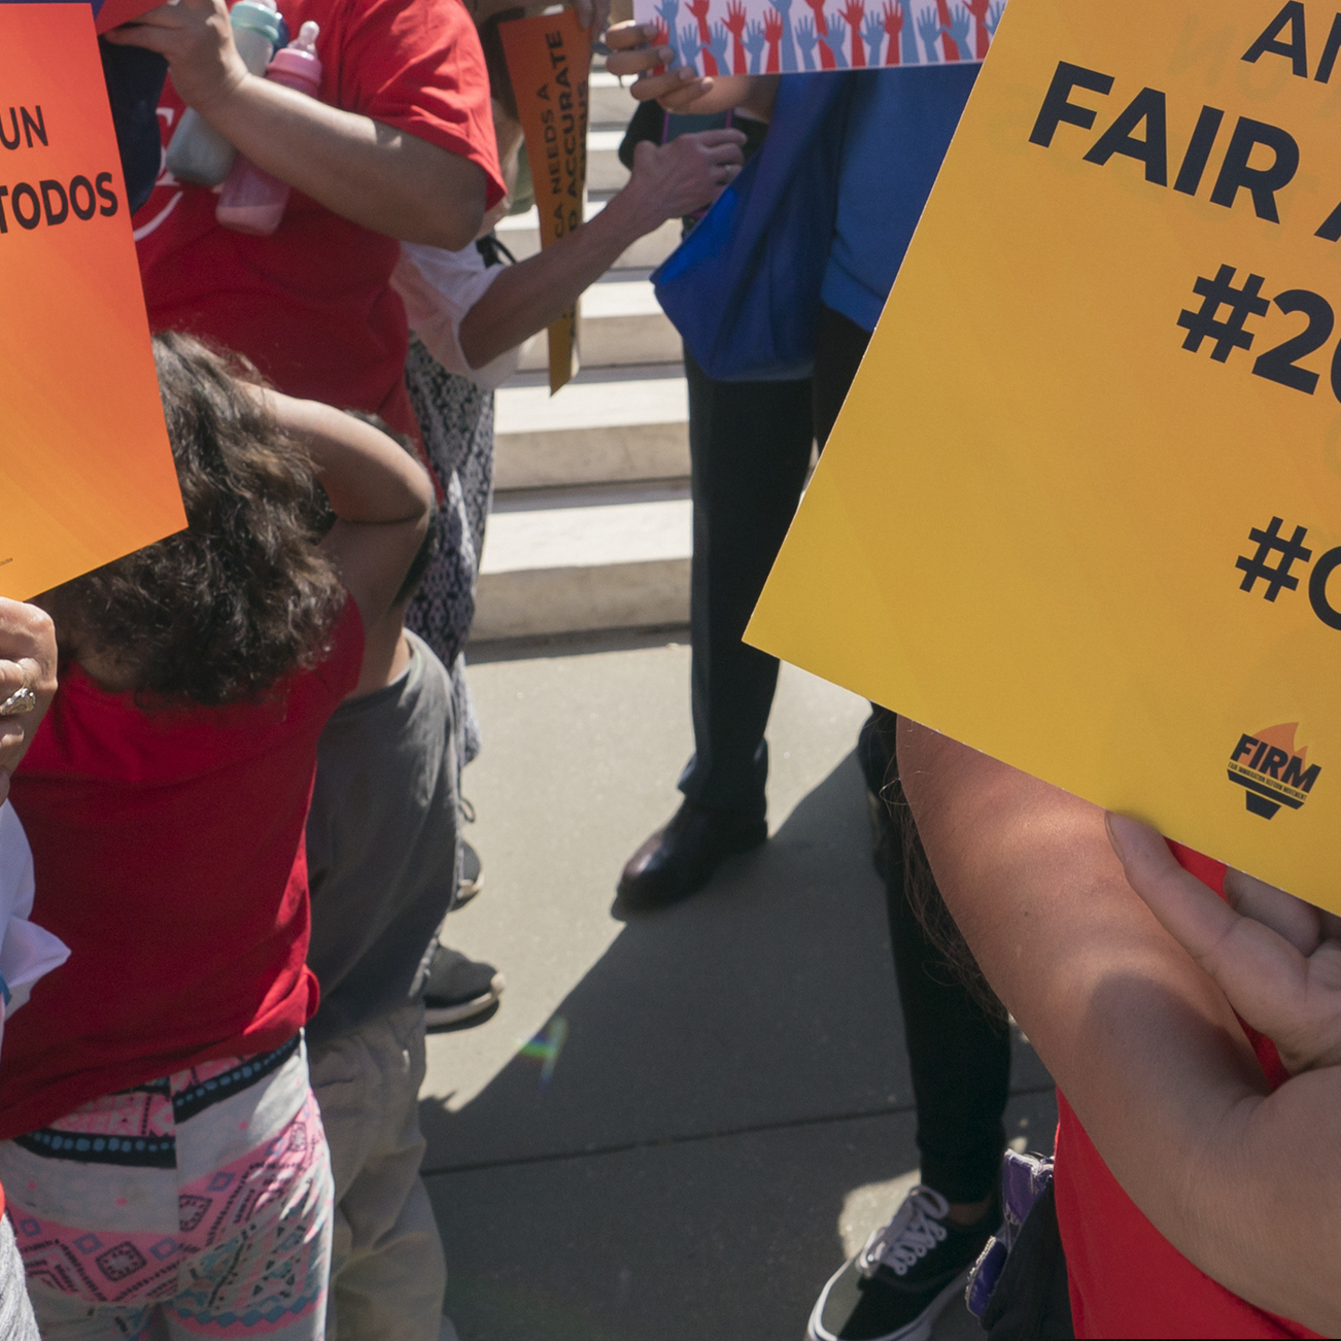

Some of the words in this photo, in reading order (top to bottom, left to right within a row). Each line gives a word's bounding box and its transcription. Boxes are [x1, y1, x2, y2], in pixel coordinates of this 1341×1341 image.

[536, 83, 551, 101] A
[544, 30, 578, 198] ACCURATE
[541, 109, 562, 195] NEEDS
[1027, 60, 1302, 225] FAIR
[1230, 733, 1322, 794] FIRM
